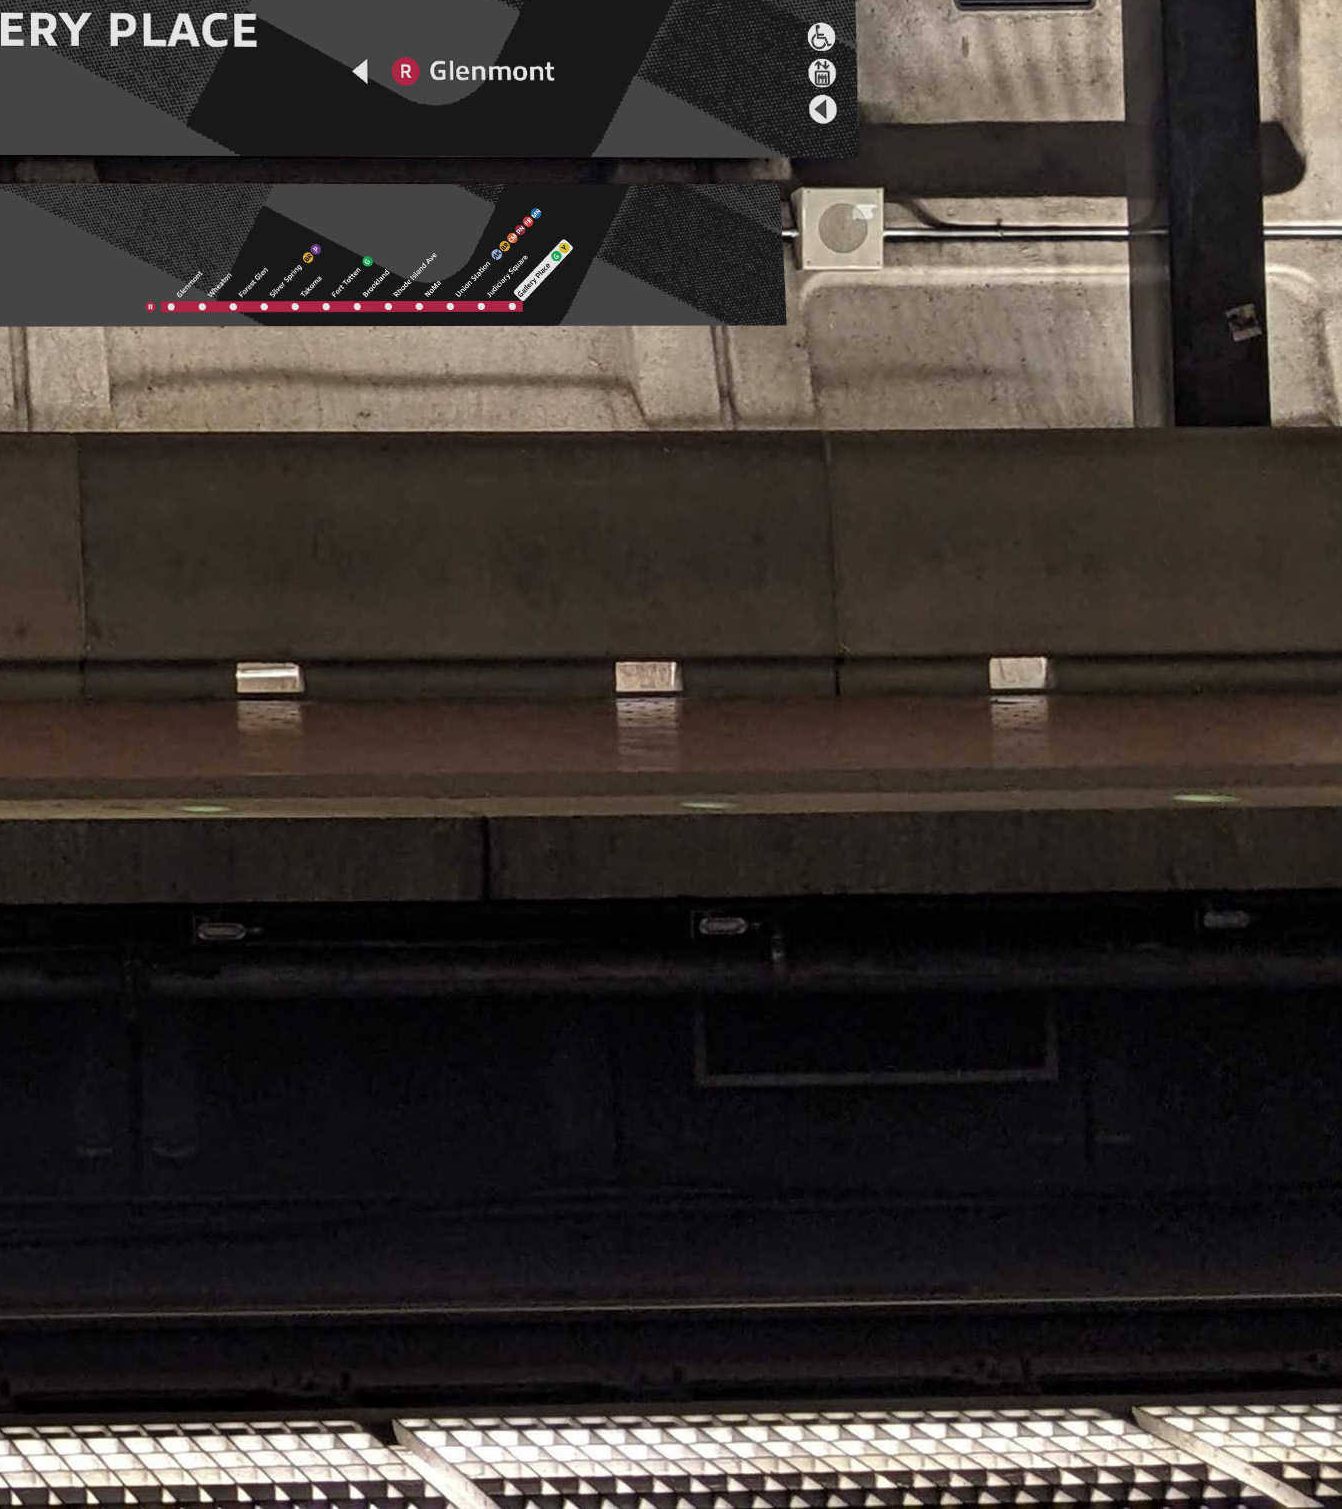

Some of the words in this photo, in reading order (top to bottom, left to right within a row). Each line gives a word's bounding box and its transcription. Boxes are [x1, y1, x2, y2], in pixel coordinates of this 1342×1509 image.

[111, 13, 256, 47] PLACE
[401, 64, 411, 78] R
[430, 61, 554, 81] Glenmont
[176, 270, 203, 298] Glenmont
[207, 272, 233, 298] Wheaton
[238, 279, 257, 298] Forest
[253, 267, 269, 282] Glen
[269, 280, 286, 298] Silver
[283, 264, 303, 283] Spring
[300, 275, 323, 298] Takoma
[331, 284, 345, 298] Fort
[341, 267, 362, 286] Totten
[362, 268, 390, 298] Brookland
[393, 278, 412, 298] Rhode
[410, 263, 427, 281] Island
[425, 252, 438, 265] Ave
[424, 280, 442, 298] NoMa
[455, 279, 473, 298] Union
[470, 261, 492, 282] Station
[487, 275, 511, 298] Judiciary
[508, 255, 529, 276] Square
[517, 278, 537, 298] Gallery
[535, 263, 551, 279] Place
